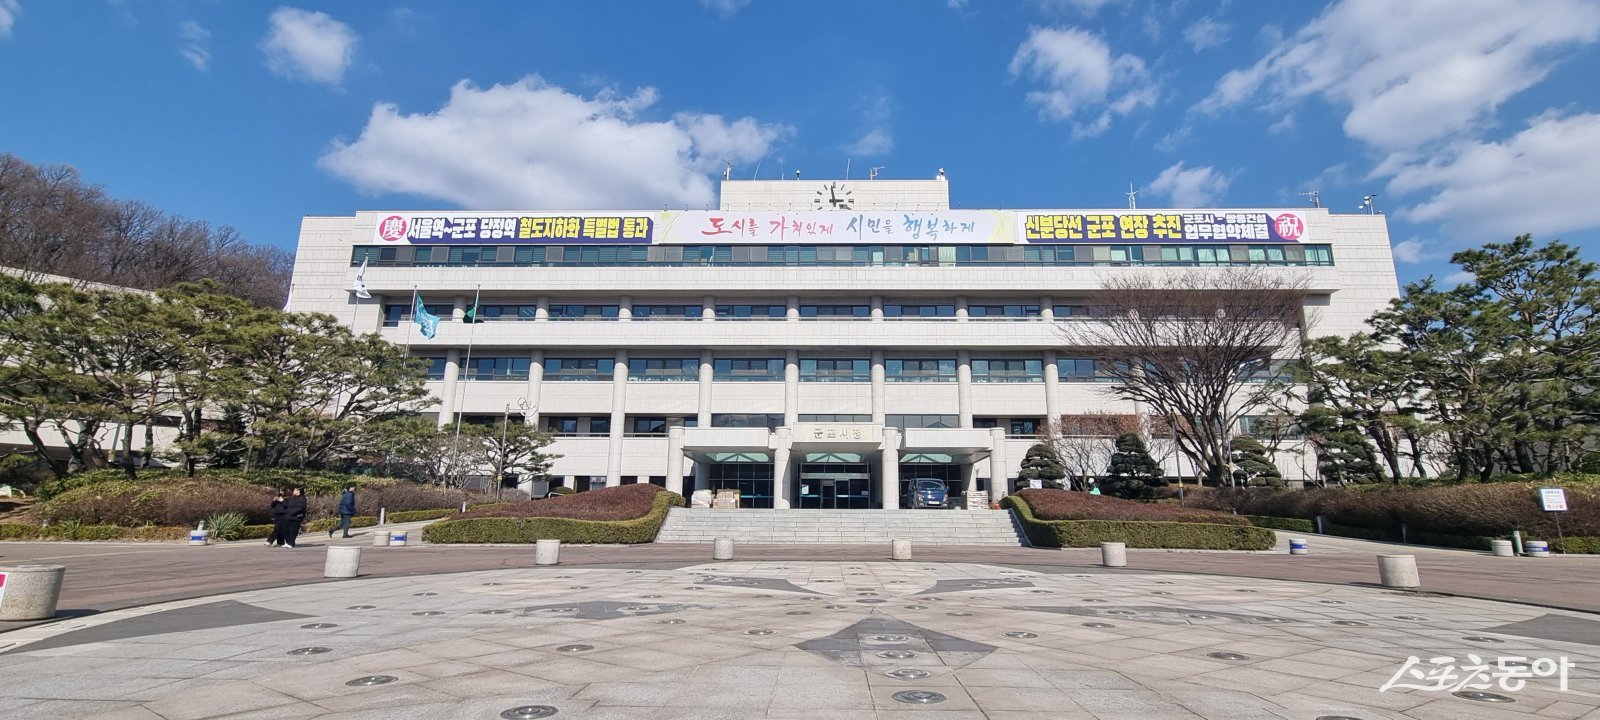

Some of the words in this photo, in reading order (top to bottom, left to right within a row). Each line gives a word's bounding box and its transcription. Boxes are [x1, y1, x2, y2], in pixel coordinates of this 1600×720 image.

[382, 218, 403, 239] 慶
[407, 217, 478, 239] 서울역~군포
[480, 217, 517, 239] 당정역
[518, 217, 581, 239] 철도지하화
[583, 217, 620, 239] 특별법
[622, 217, 648, 239] 통과
[701, 217, 760, 237] 도시를
[769, 216, 834, 241] 가치있게
[846, 214, 894, 240] 시민을
[903, 214, 975, 241] 행복하게
[1025, 215, 1083, 239] 신분당선
[1086, 215, 1117, 239] 군포
[1119, 215, 1149, 239] 연장
[1152, 214, 1182, 239] 추진
[1183, 213, 1215, 224] 군포시
[1225, 213, 1267, 224] 쌍용건설
[1278, 216, 1300, 238] 祝
[1184, 223, 1270, 240] 업무협약체결
